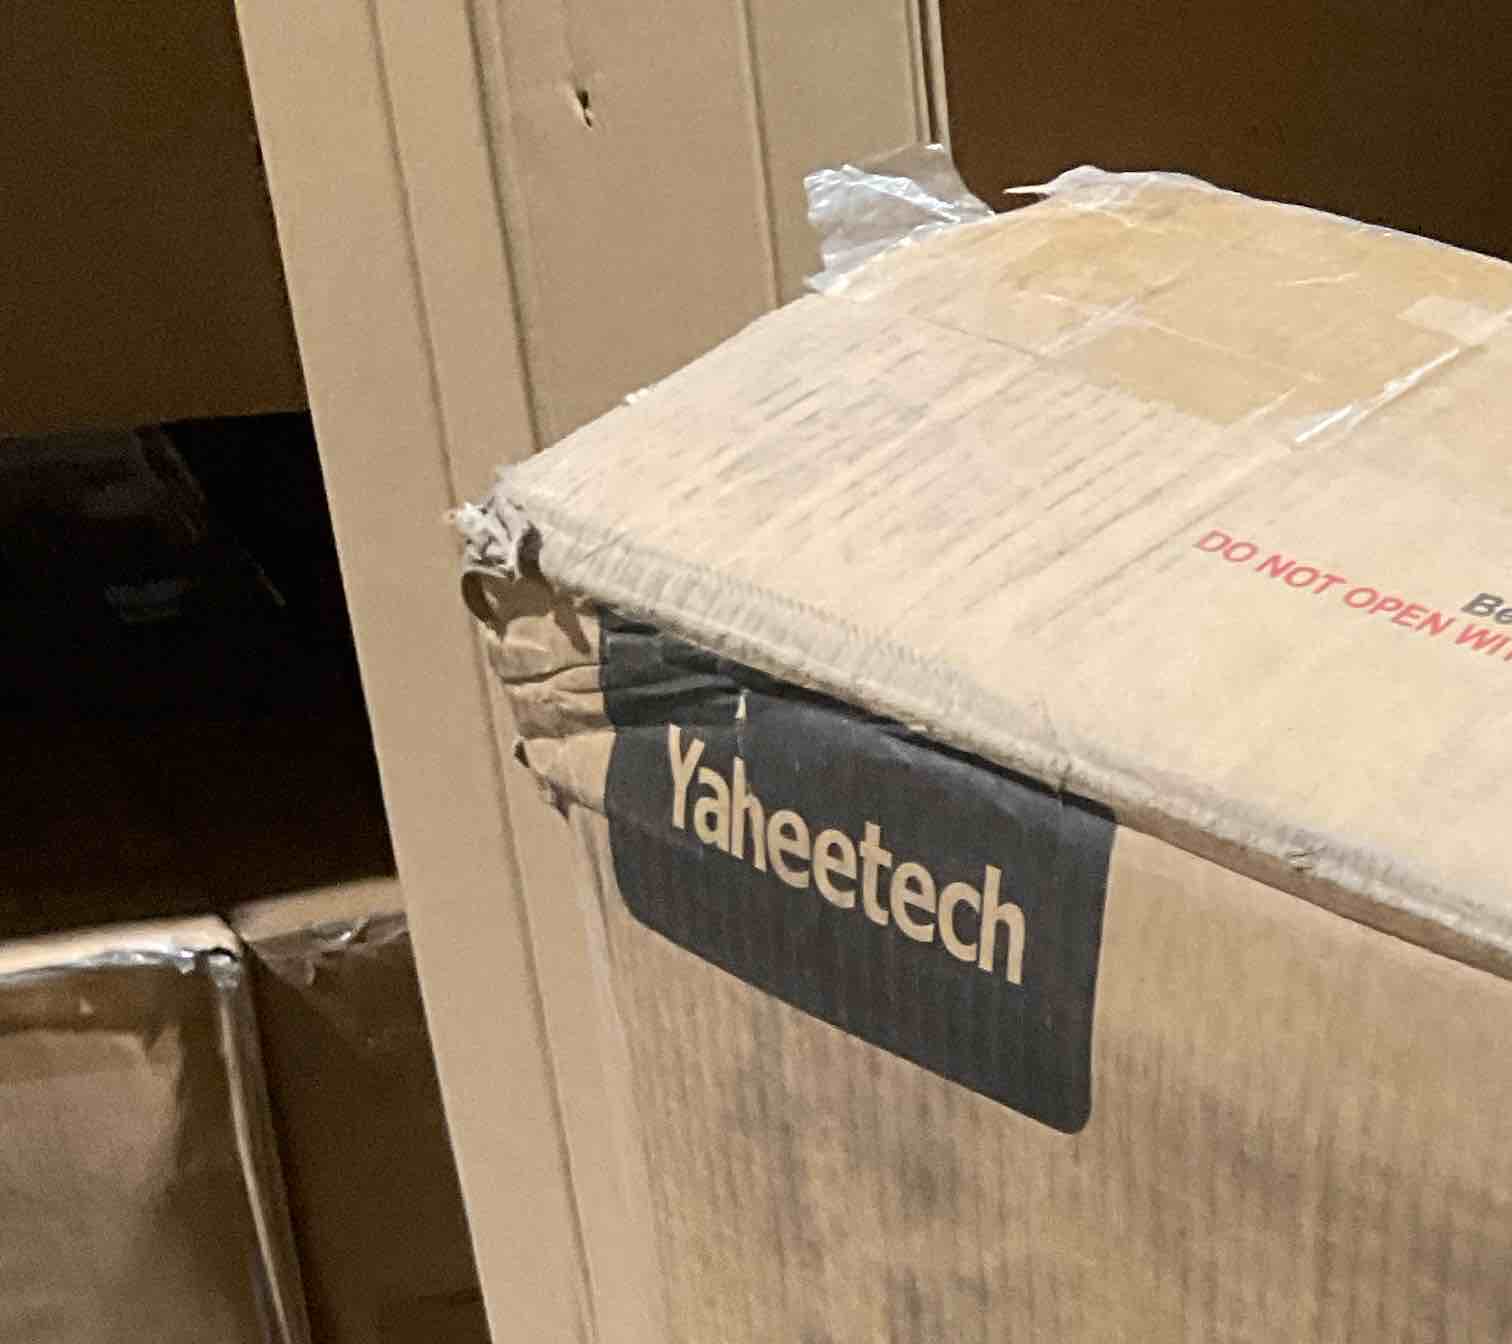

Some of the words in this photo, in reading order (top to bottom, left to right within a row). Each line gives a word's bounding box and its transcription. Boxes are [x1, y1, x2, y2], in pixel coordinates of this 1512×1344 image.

[1193, 528, 1257, 564] DO
[1253, 550, 1344, 598] NOT
[1341, 585, 1454, 637] OPEN
[667, 723, 1026, 986] Yaheetech
